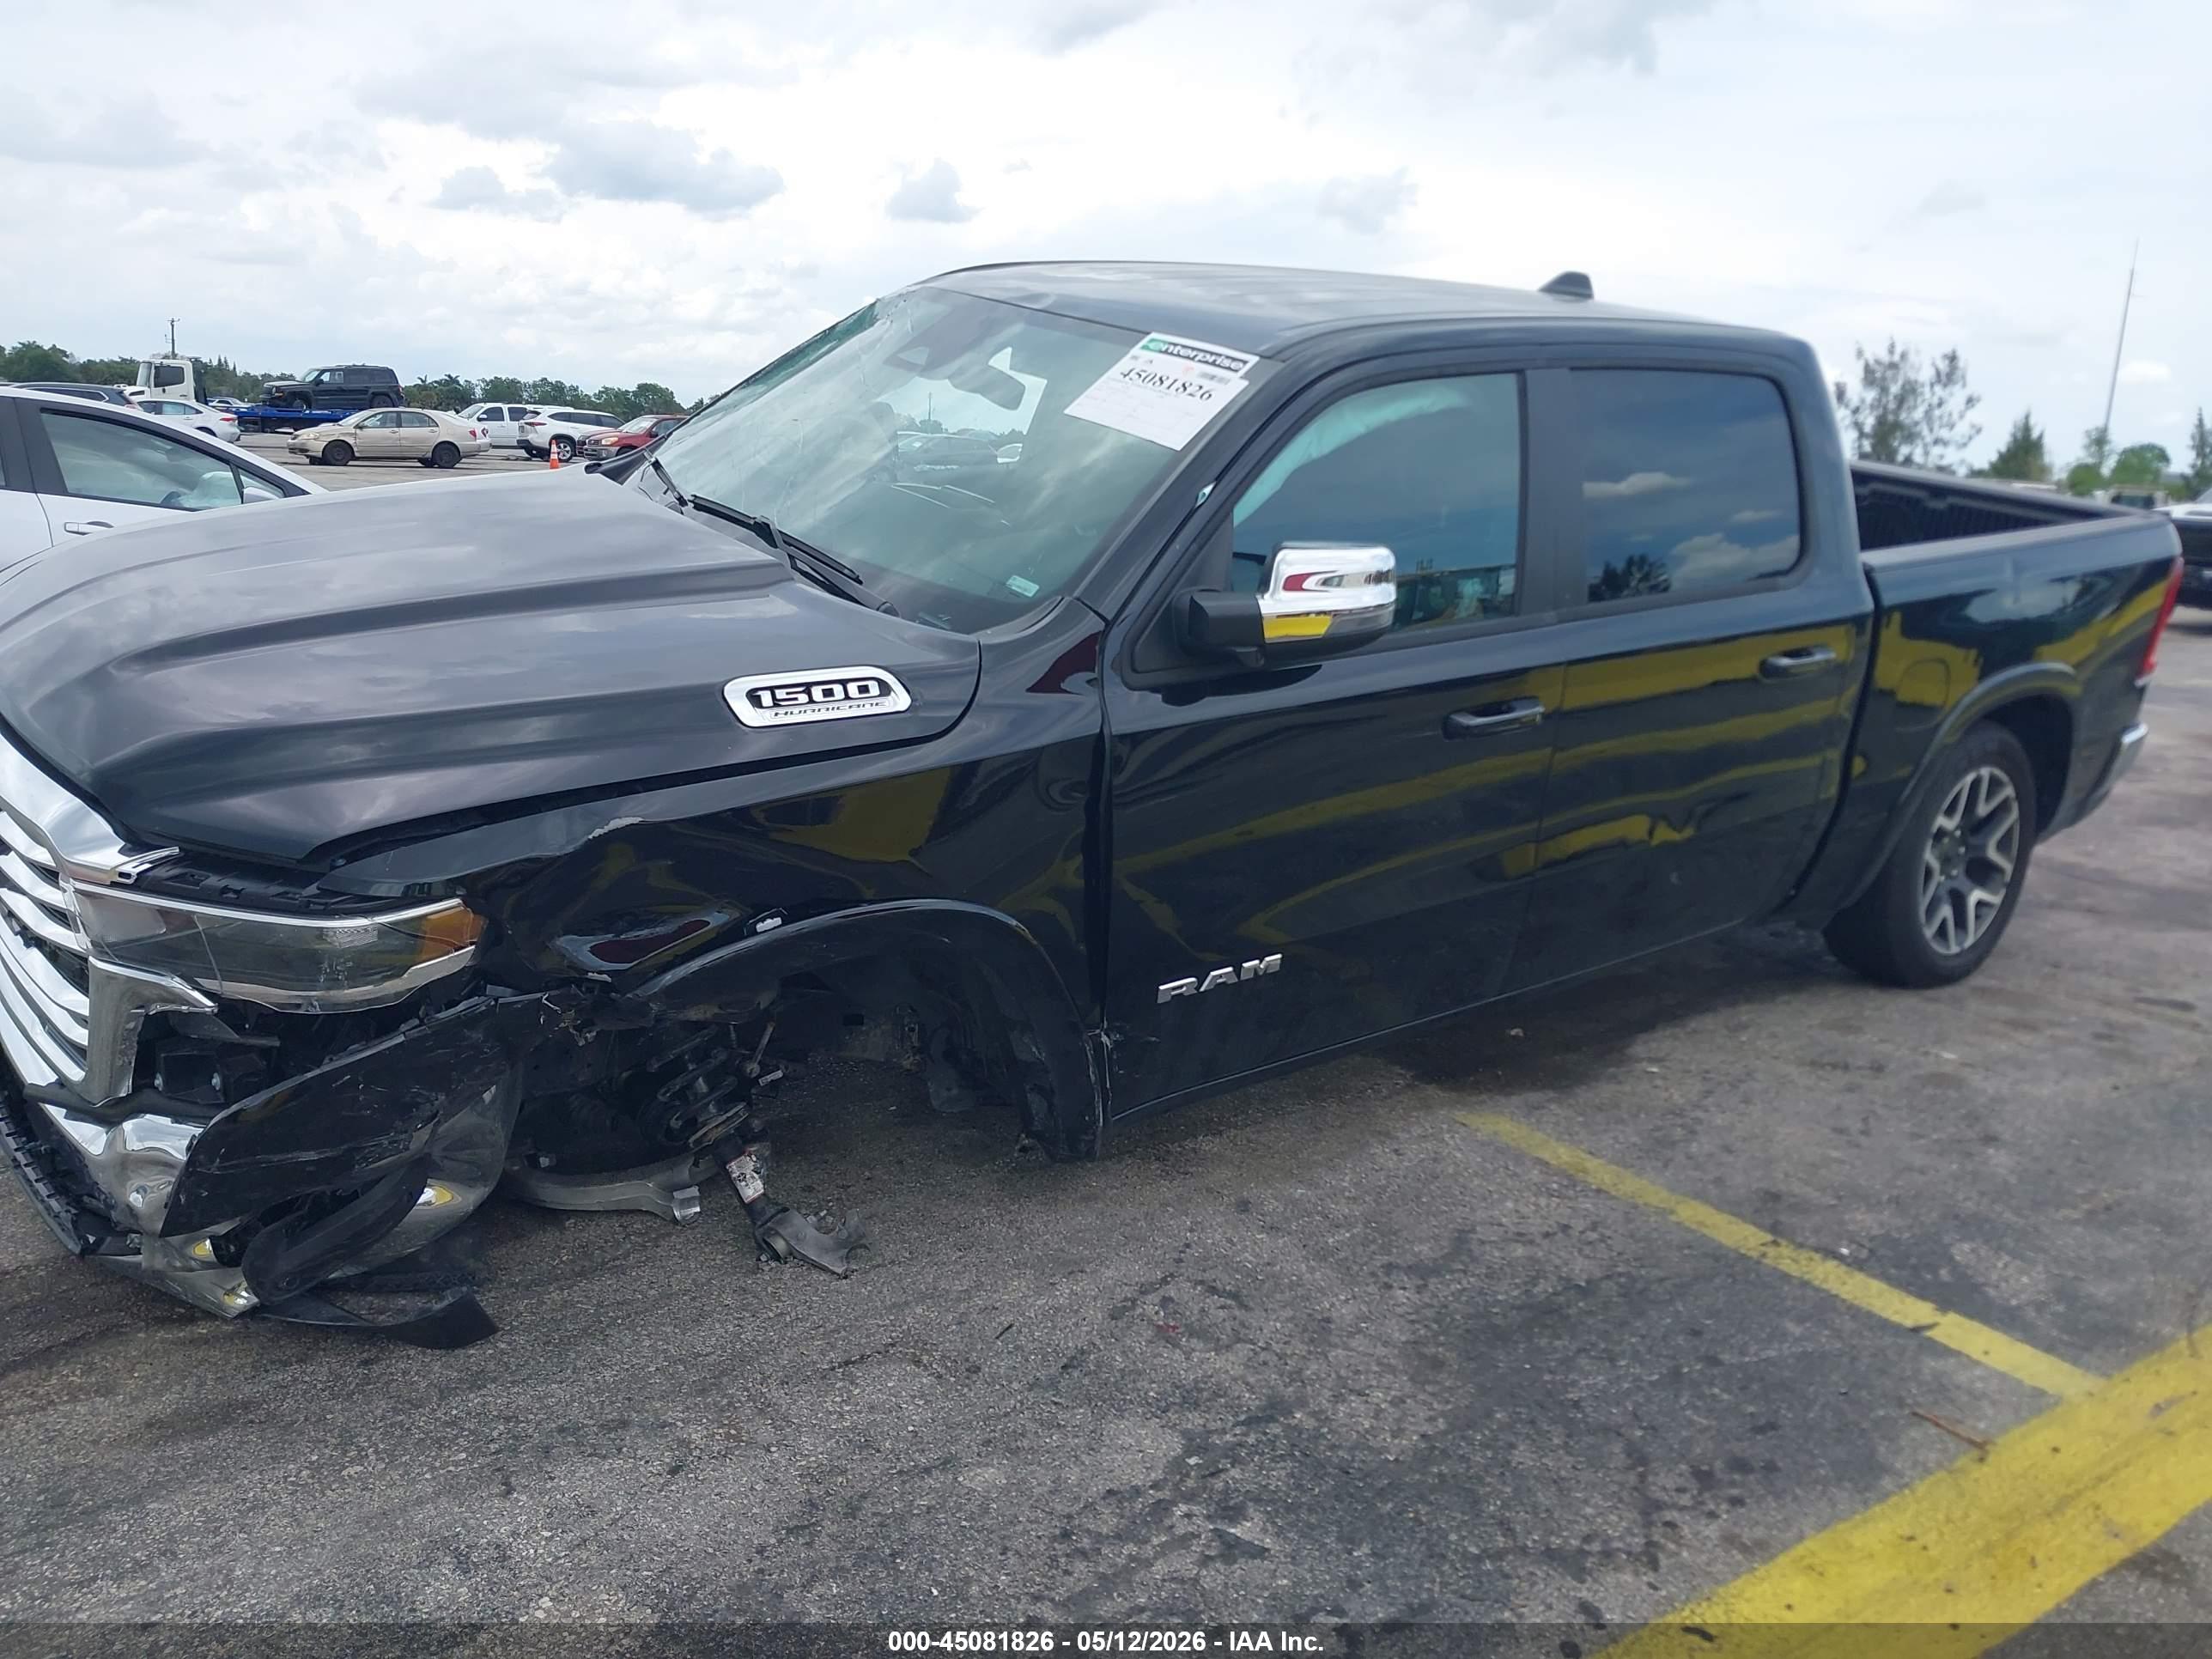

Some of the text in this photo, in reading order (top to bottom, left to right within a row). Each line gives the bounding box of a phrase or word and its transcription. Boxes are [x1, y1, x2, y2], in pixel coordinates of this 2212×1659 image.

[1146, 338, 1245, 372] enterprise
[1120, 367, 1213, 402] 45081826
[752, 680, 880, 708] 1500
[774, 701, 888, 718] HURRICANE
[1157, 953, 1283, 1004] RAM
